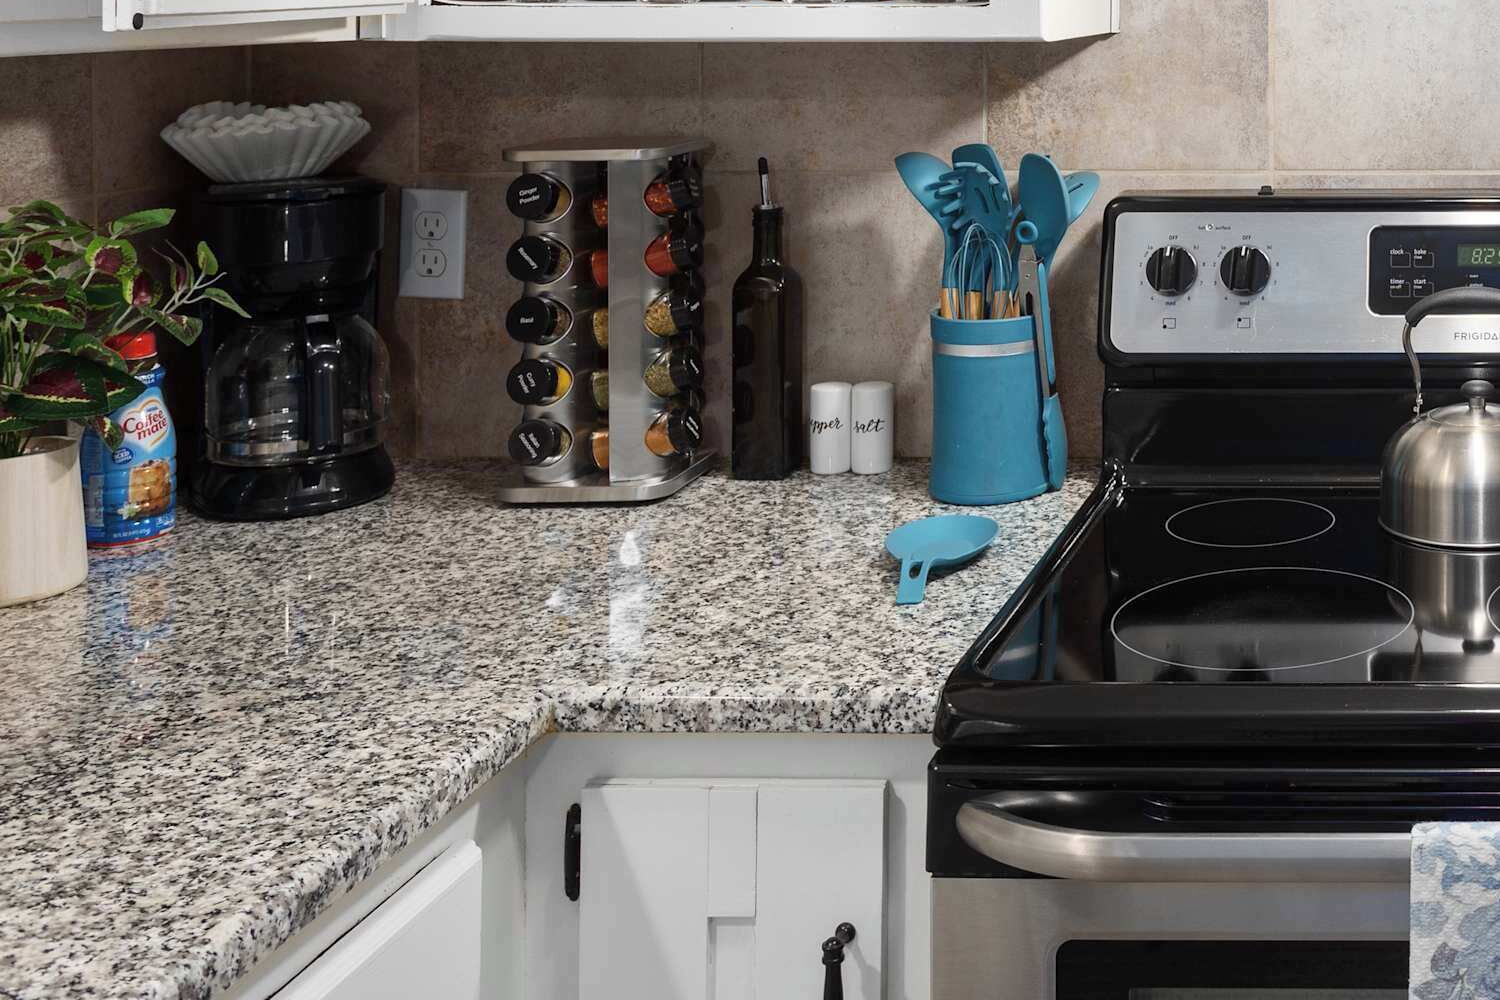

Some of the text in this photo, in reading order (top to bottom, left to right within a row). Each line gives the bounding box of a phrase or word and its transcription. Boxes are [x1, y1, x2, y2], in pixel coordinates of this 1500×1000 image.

[122, 409, 163, 434] Coffee
[136, 416, 168, 441] mate
[854, 418, 886, 433] salt
